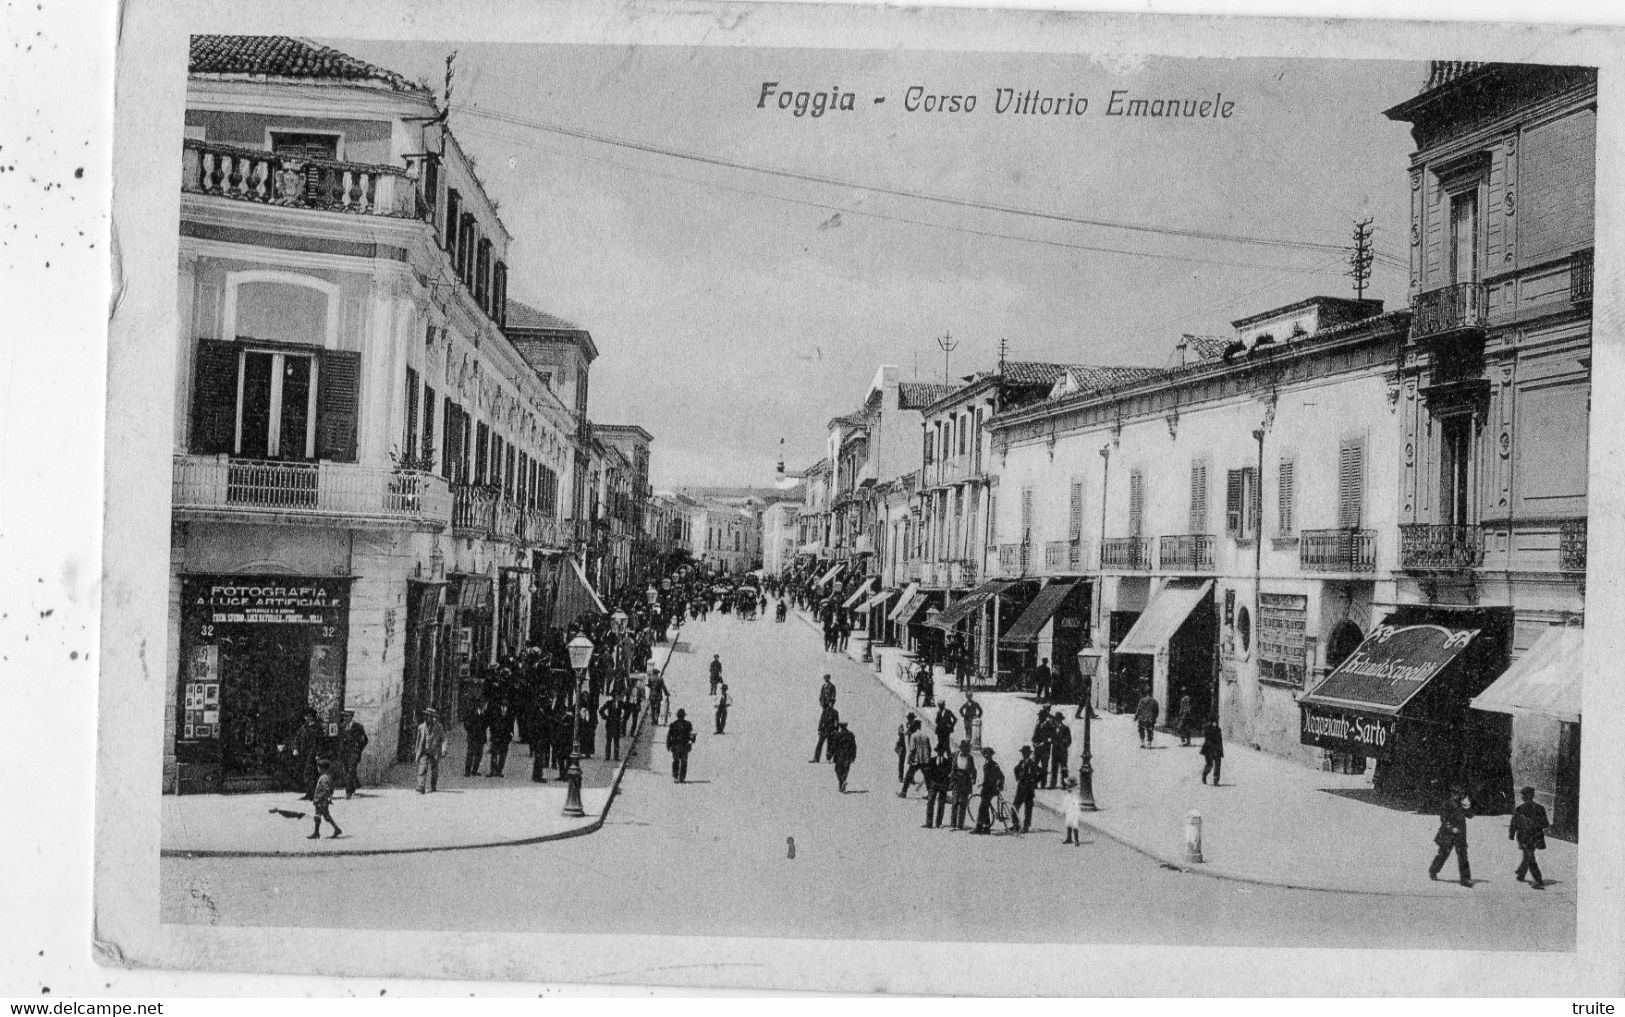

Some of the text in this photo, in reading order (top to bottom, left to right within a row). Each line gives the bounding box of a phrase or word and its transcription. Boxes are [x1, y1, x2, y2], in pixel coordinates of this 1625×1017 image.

[211, 586, 327, 597] FOTOGRAFIA
[196, 597, 205, 606] A
[255, 598, 341, 608] ARTIFICIALE
[200, 624, 214, 636] 32
[322, 626, 335, 638] 32
